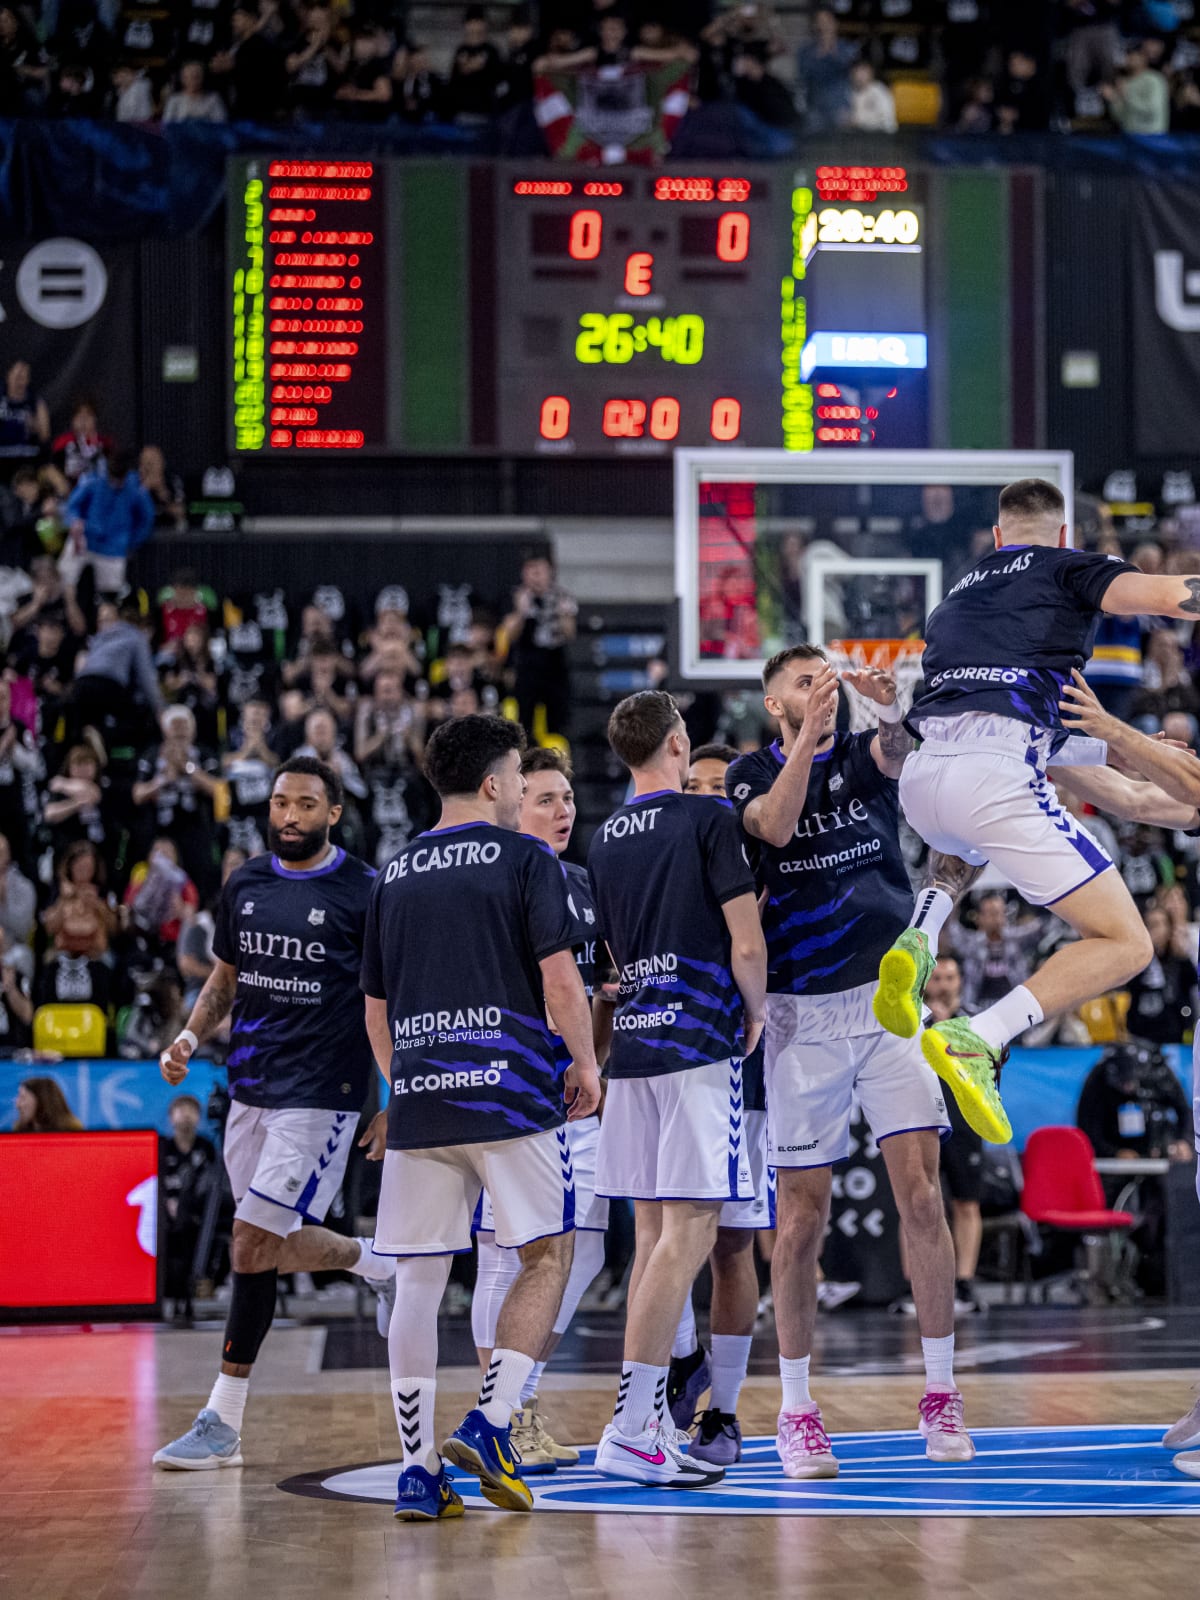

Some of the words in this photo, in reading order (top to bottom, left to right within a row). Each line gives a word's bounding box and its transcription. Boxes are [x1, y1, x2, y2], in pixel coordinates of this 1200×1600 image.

[569, 210, 602, 260] 0
[716, 211, 750, 262] 0
[575, 312, 705, 365] 26:40
[539, 396, 571, 440] 0
[710, 397, 742, 441] 0
[943, 667, 1018, 684] CORREO
[603, 807, 663, 843] FONT
[384, 852, 409, 884] DE
[412, 841, 501, 873] CASTRO
[779, 838, 881, 873] azulmarino
[856, 853, 883, 868] travel
[239, 928, 327, 963] surne
[238, 970, 322, 993] zulmarino
[394, 1006, 501, 1040] MEDRANO
[619, 1010, 677, 1030] CORREO
[394, 1035, 426, 1051] Obras
[428, 1034, 436, 1047] y
[438, 1029, 502, 1043] Servicios
[394, 1078, 409, 1096] EL
[410, 1068, 501, 1093] CORREO
[787, 1142, 817, 1152] CORREO
